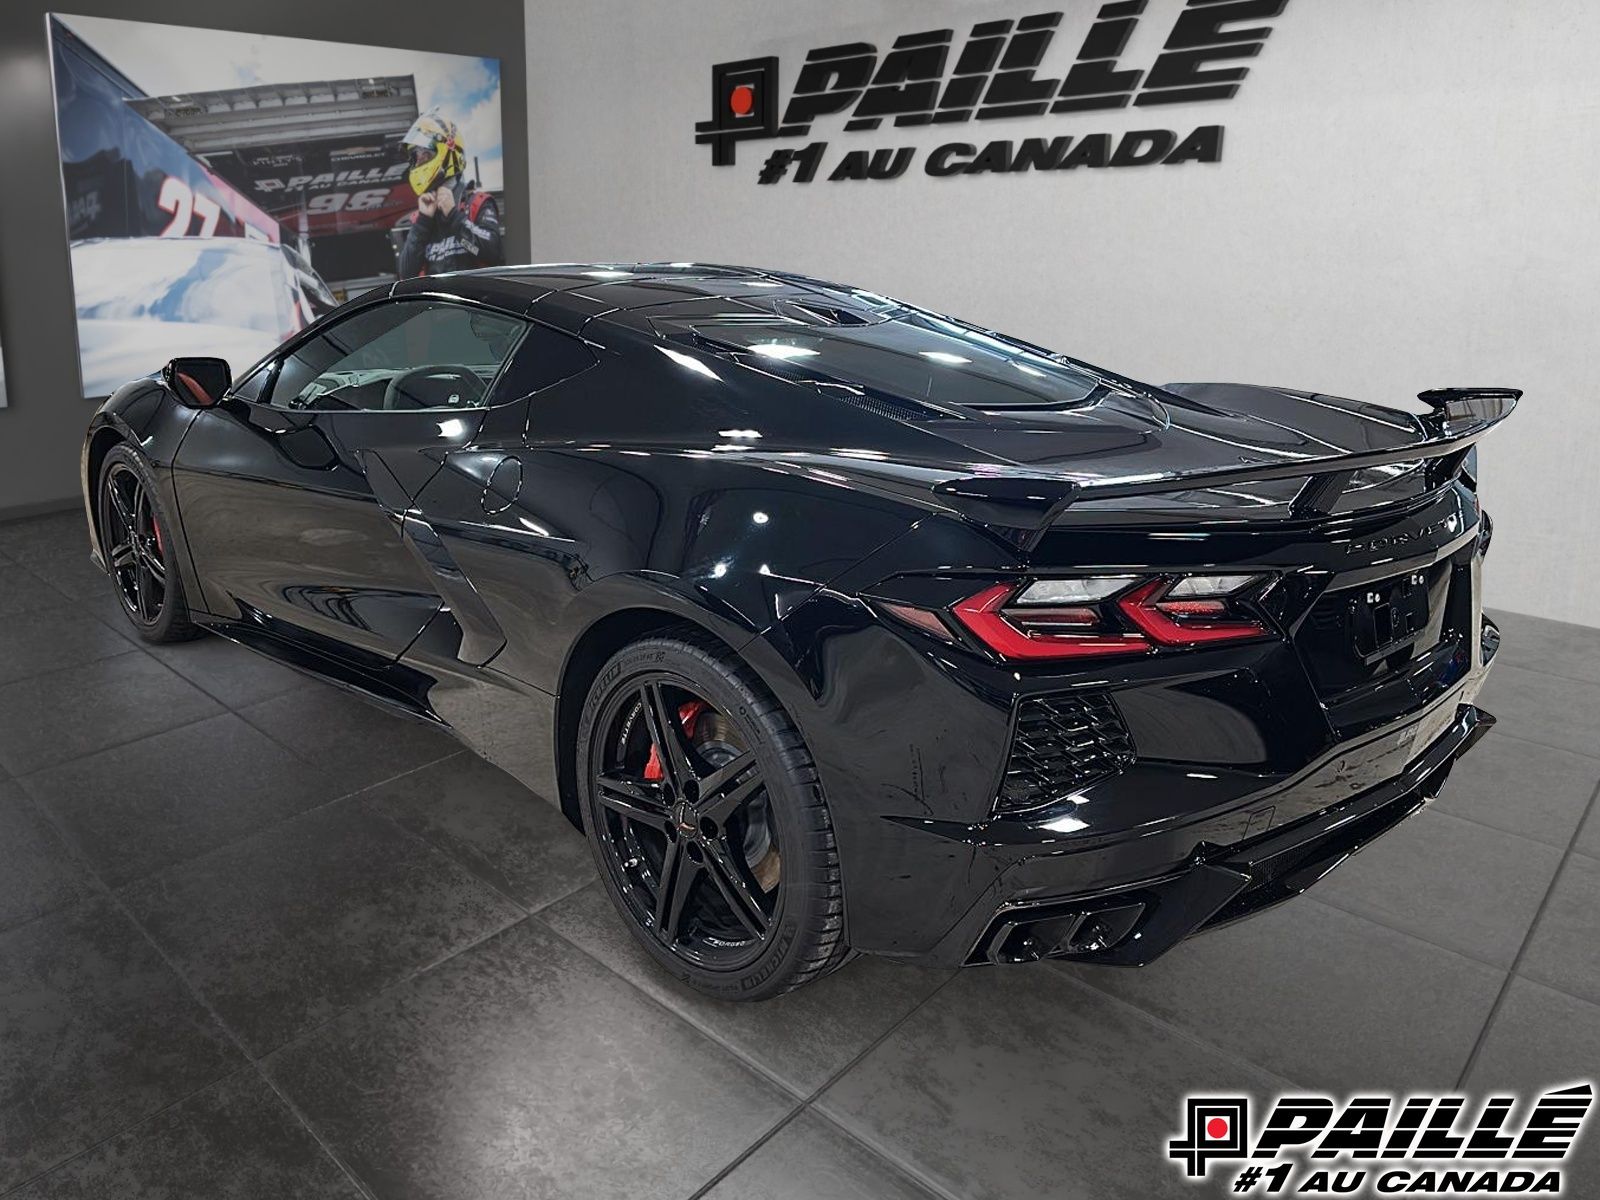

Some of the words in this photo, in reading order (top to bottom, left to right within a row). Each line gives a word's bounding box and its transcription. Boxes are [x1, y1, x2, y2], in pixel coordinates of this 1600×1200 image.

[757, 142, 828, 184] #1
[828, 147, 915, 181] AU
[924, 125, 1225, 177] CANADA
[307, 188, 391, 215] 96
